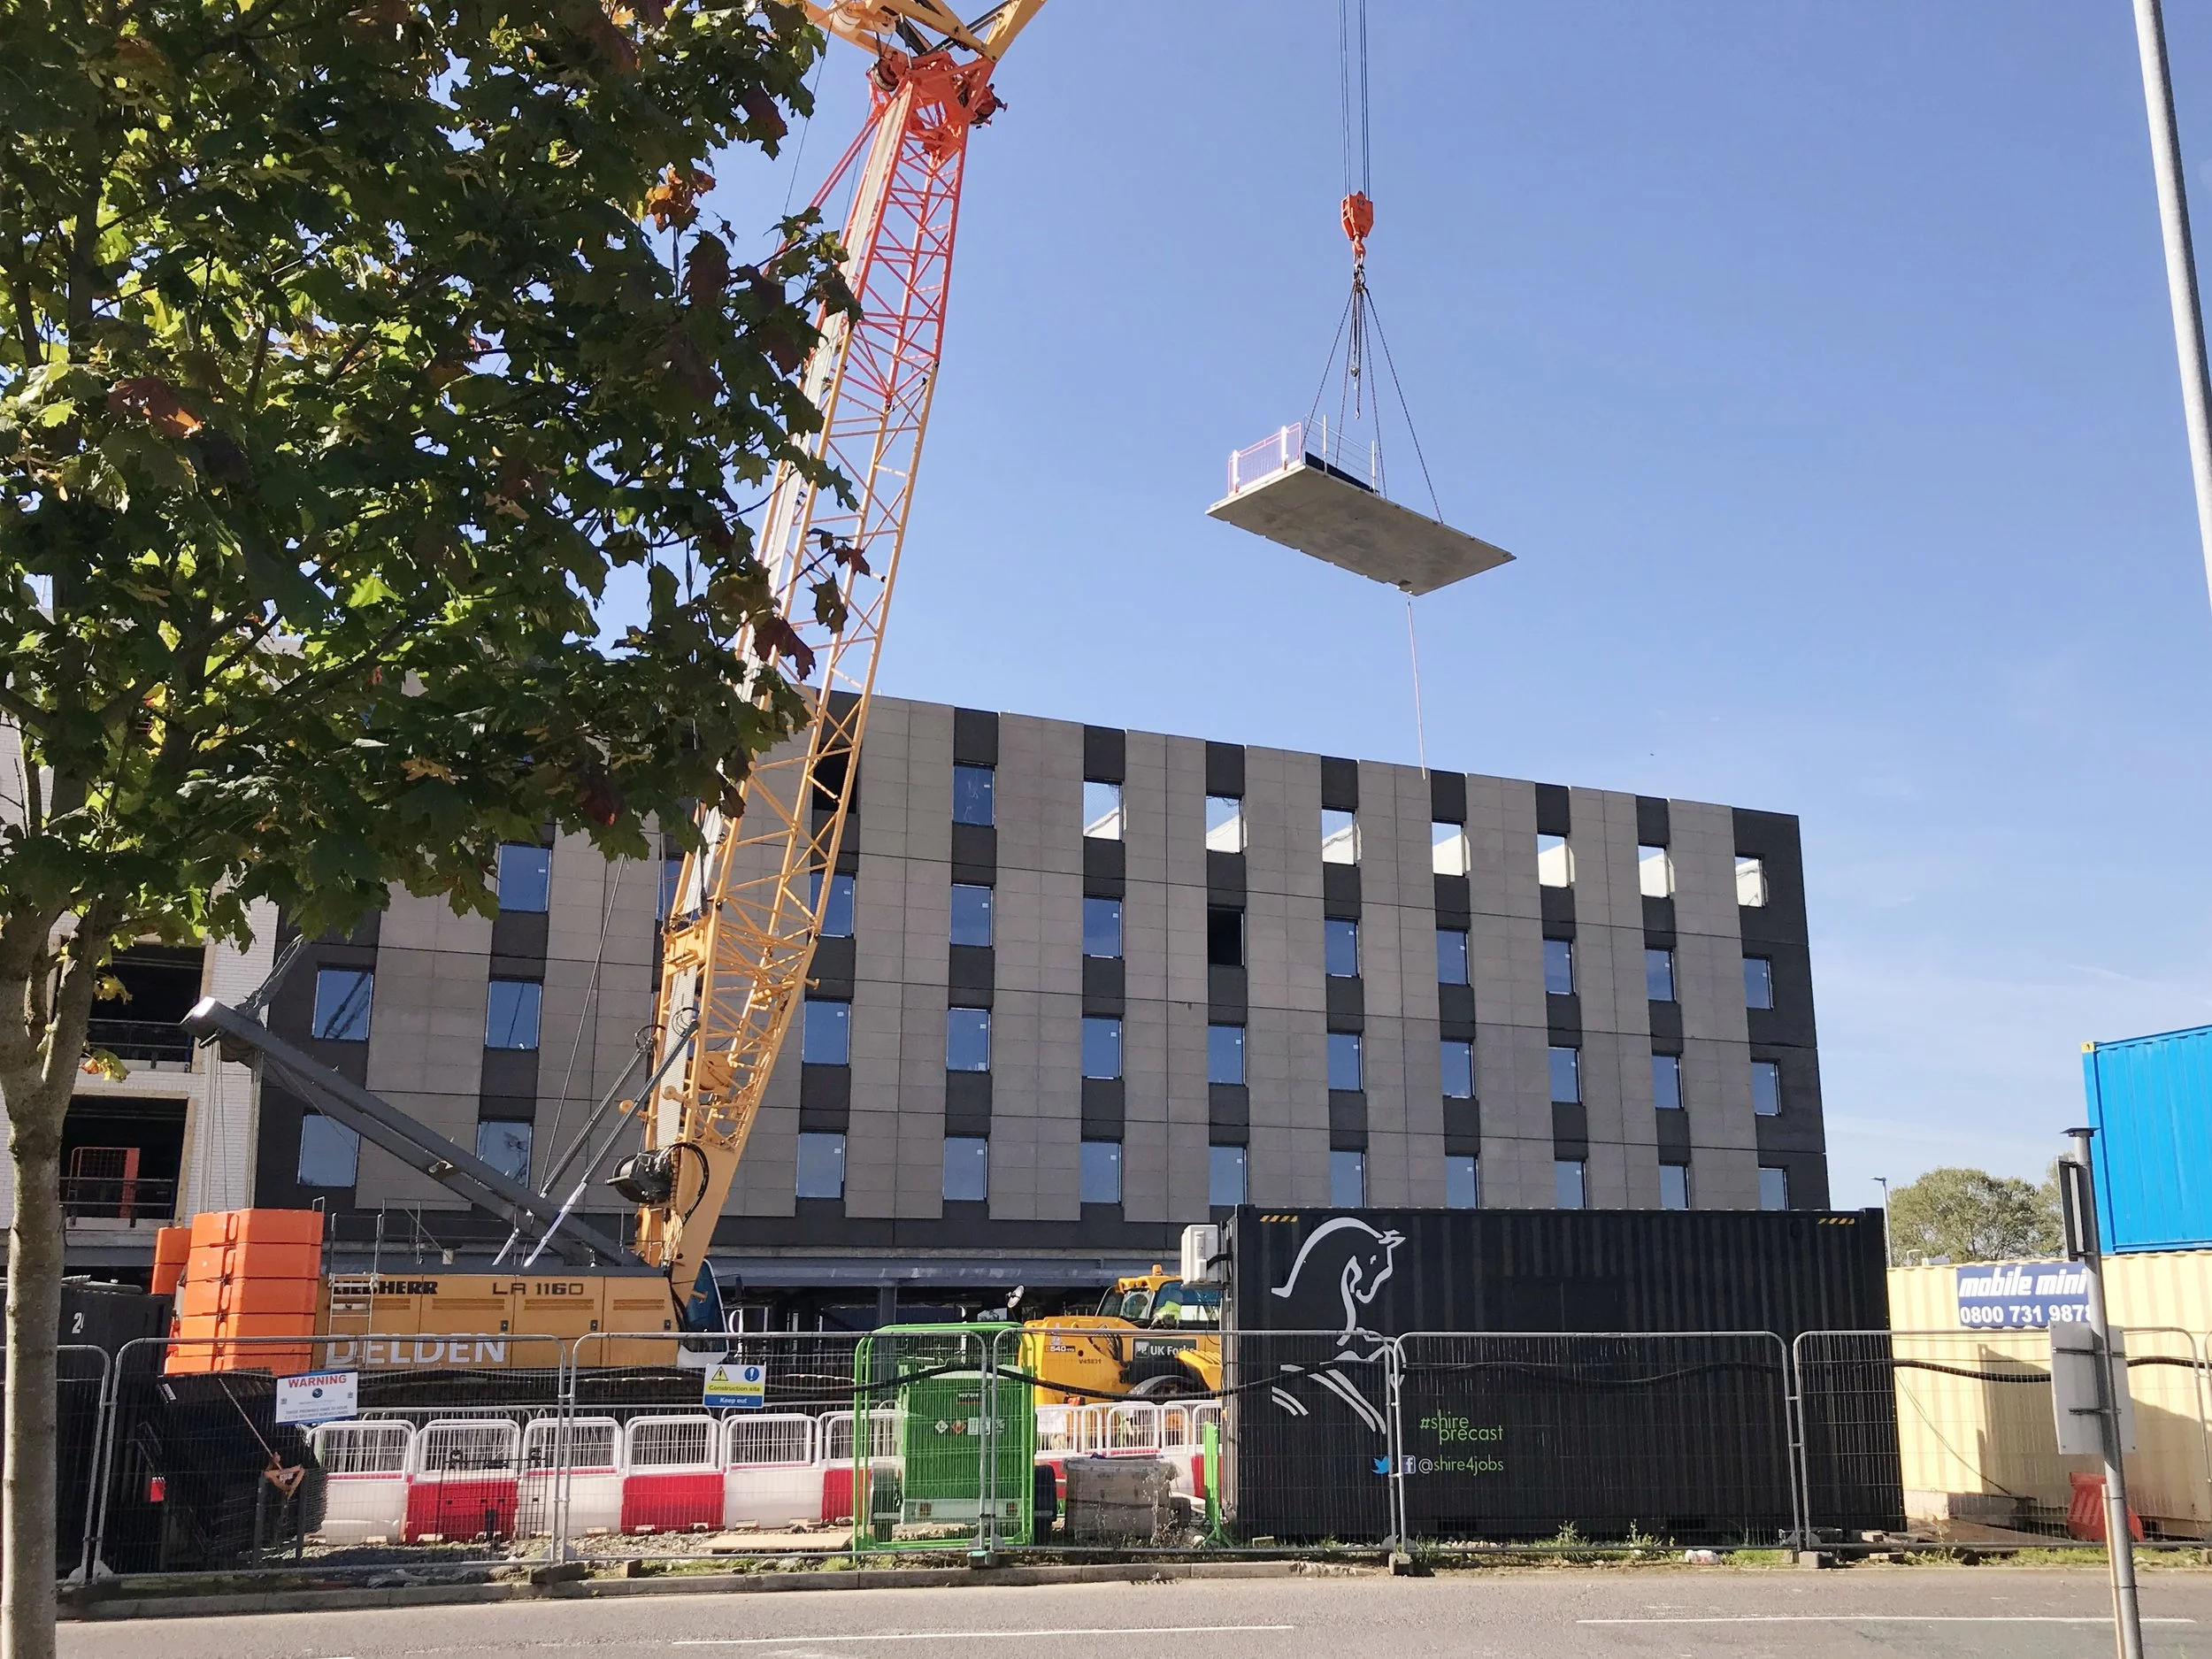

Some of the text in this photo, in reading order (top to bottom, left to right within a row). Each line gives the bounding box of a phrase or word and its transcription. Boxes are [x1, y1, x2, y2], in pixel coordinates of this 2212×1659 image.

[493, 1282, 584, 1295] LA 1160
[1958, 1266, 2087, 1297] mobile mini
[1960, 1305, 2004, 1324] 0800
[2008, 1304, 2042, 1323] 731
[326, 1333, 506, 1364] DELDEN
[1150, 1345, 1165, 1356] UK
[288, 1374, 347, 1388] WARNING
[1419, 1409, 1470, 1430] #shire
[1438, 1425, 1504, 1446] precast
[1418, 1454, 1504, 1477] @shire4jobs
